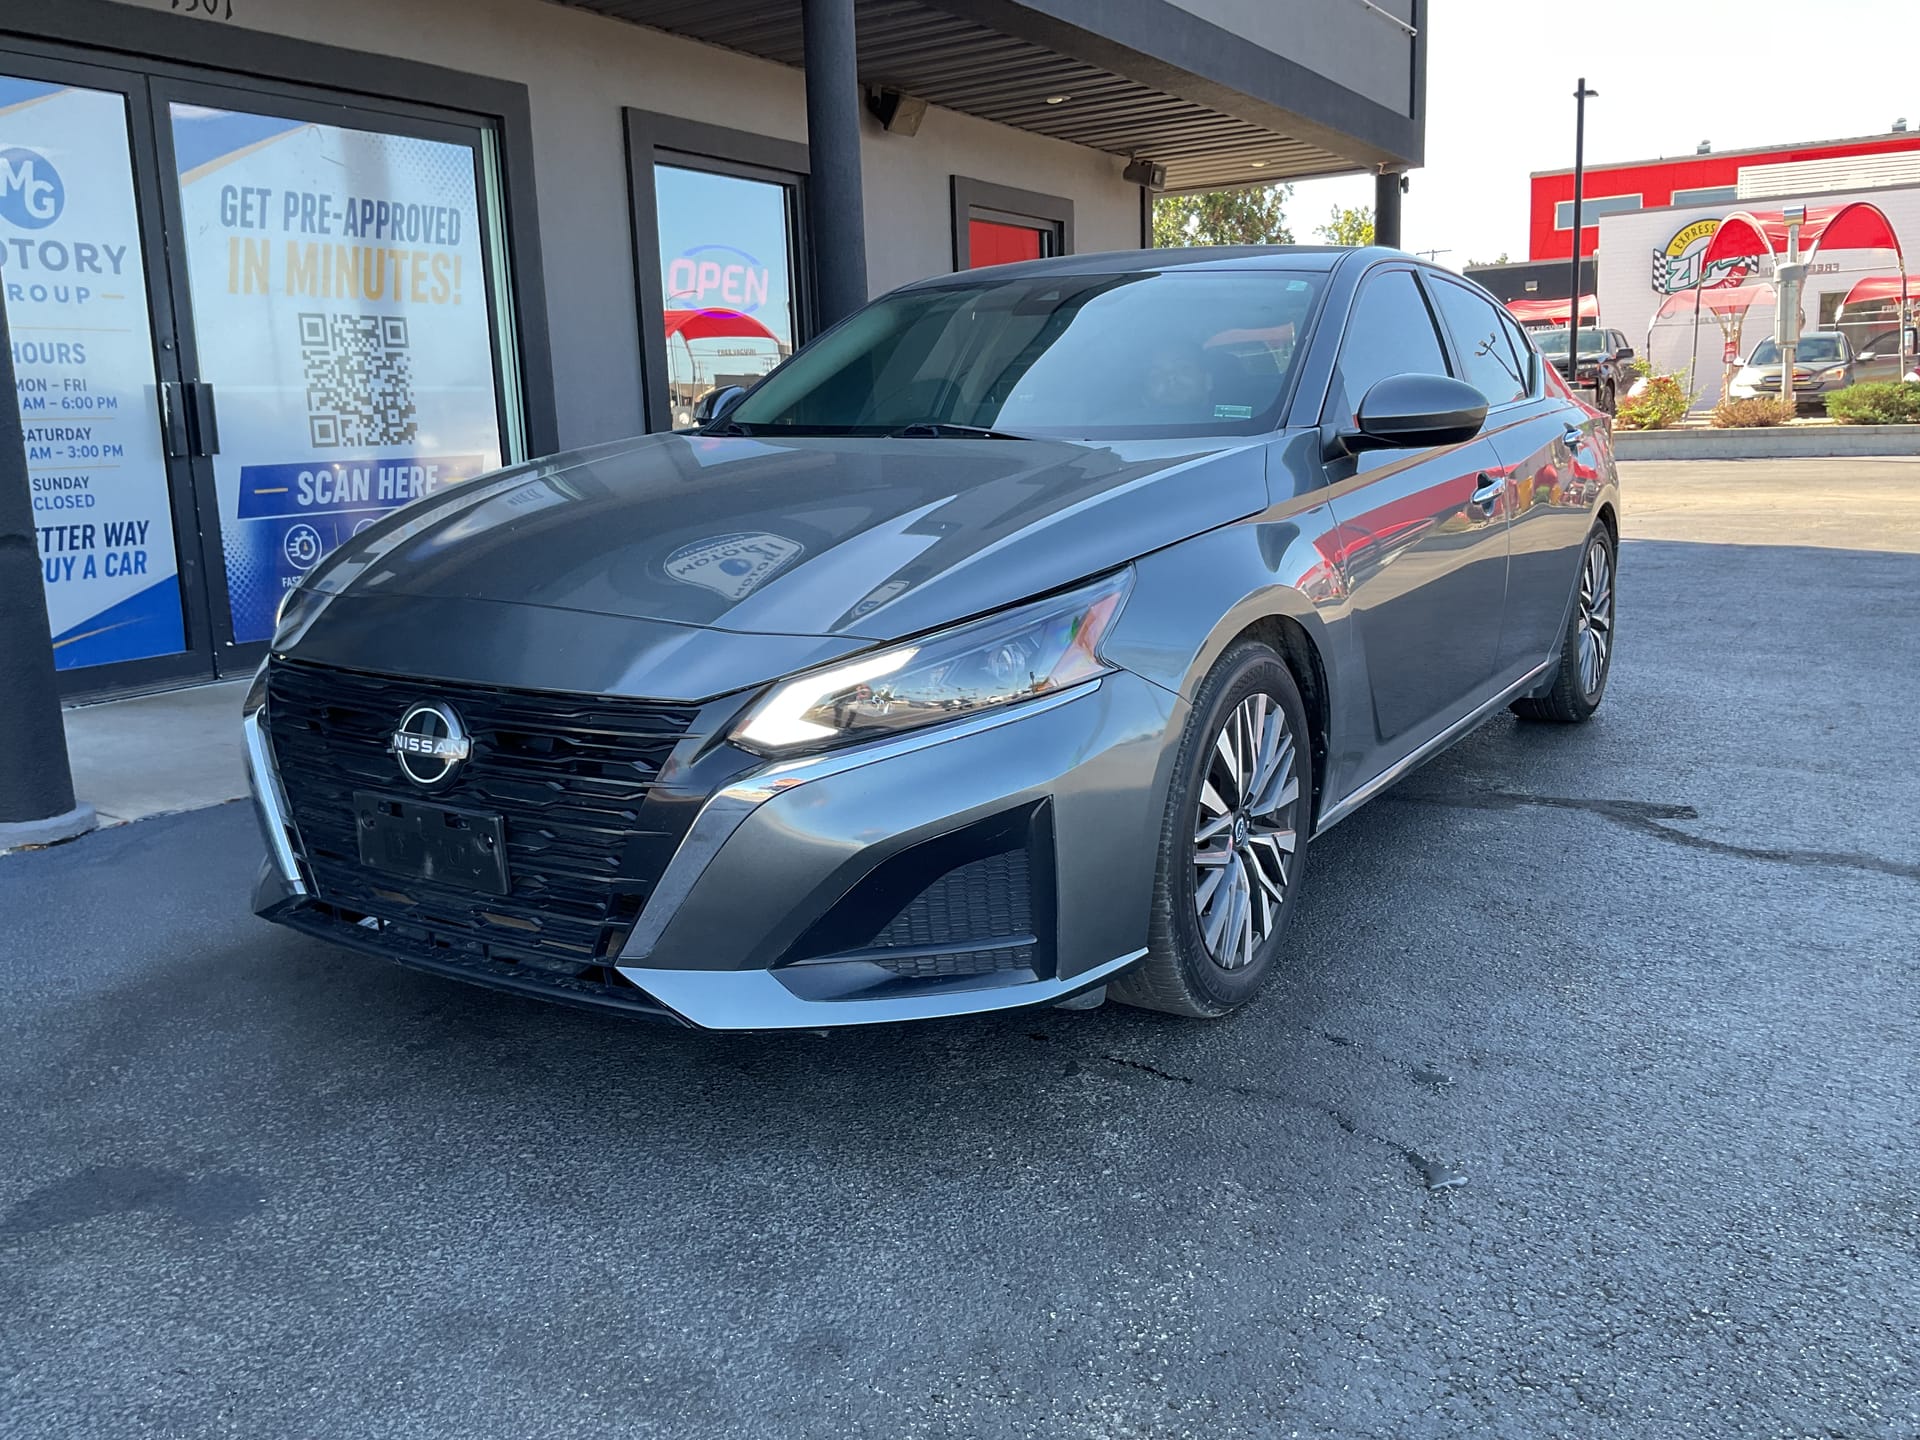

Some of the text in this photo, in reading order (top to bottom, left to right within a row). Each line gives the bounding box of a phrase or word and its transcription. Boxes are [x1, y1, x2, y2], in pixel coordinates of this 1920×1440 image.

[0, 157, 55, 219] MG
[220, 185, 461, 246] GET PRE-APPROVED
[1674, 223, 1716, 249] EXPRESS
[0, 238, 127, 275] TORY
[228, 236, 462, 305] IN MINUTES!
[668, 258, 769, 306] OPEN
[63, 378, 87, 392] FRI
[23, 397, 45, 410] AM
[61, 397, 93, 409] 6:00
[97, 396, 118, 408] PM
[23, 427, 92, 442] ATURDAY
[29, 447, 52, 460] AM
[67, 445, 99, 458] 3:00
[103, 444, 123, 457] PM
[32, 476, 90, 491] SUNDAY
[297, 464, 438, 506] SCAN HERE
[33, 494, 95, 511] CLOSED
[104, 520, 149, 547] WAY
[83, 554, 97, 580] A
[105, 550, 147, 577] CAR
[394, 734, 465, 755] NISSAN
